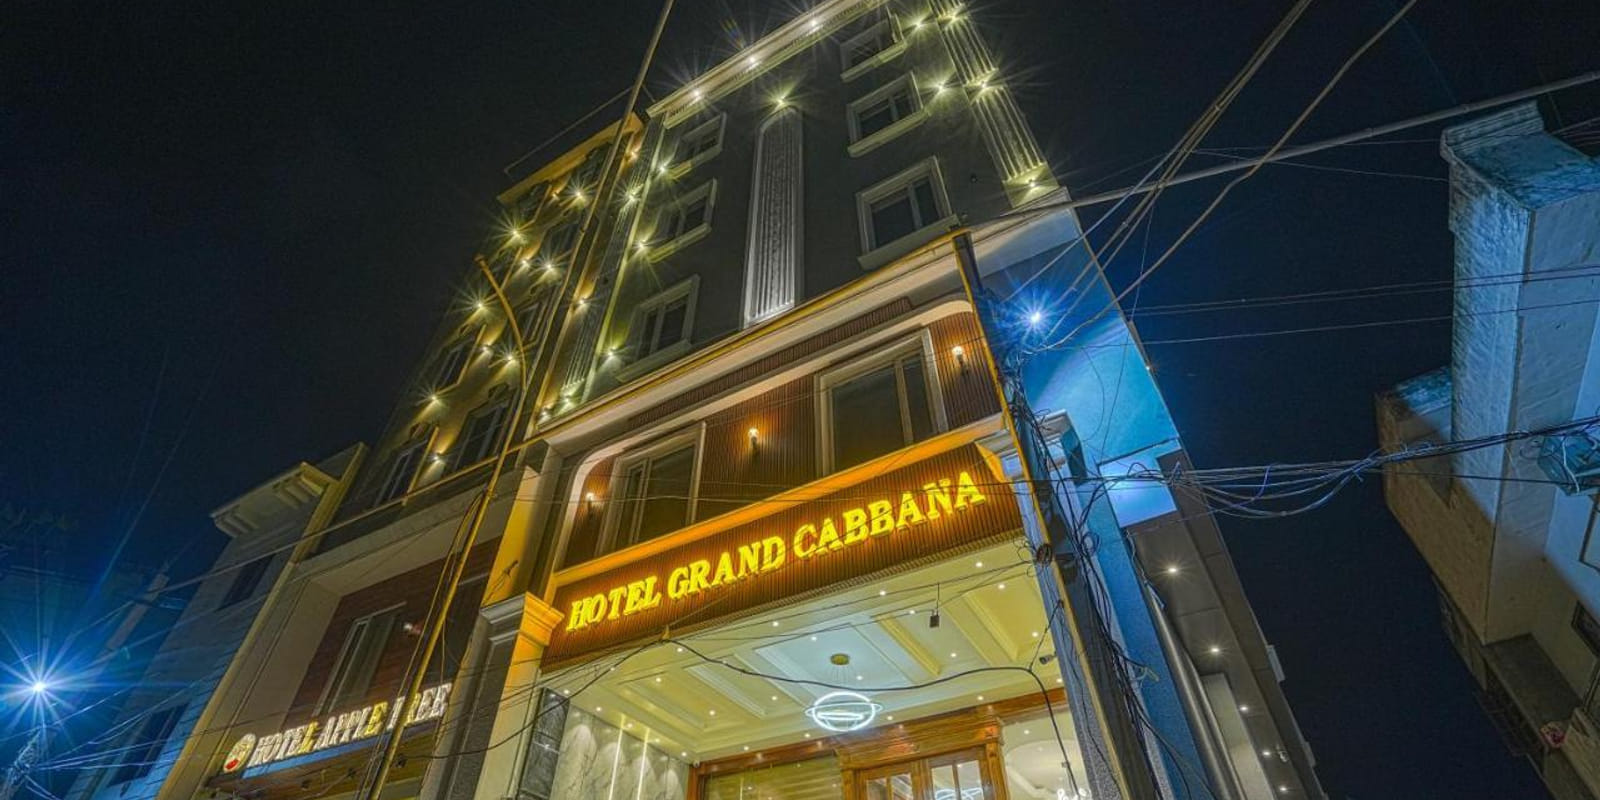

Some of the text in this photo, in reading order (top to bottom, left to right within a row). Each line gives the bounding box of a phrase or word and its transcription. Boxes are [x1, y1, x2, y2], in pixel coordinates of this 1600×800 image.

[566, 575, 662, 632] HOTEL
[667, 536, 786, 600] GRAND
[247, 721, 318, 767] HOTEL
[313, 701, 388, 750] APPLE
